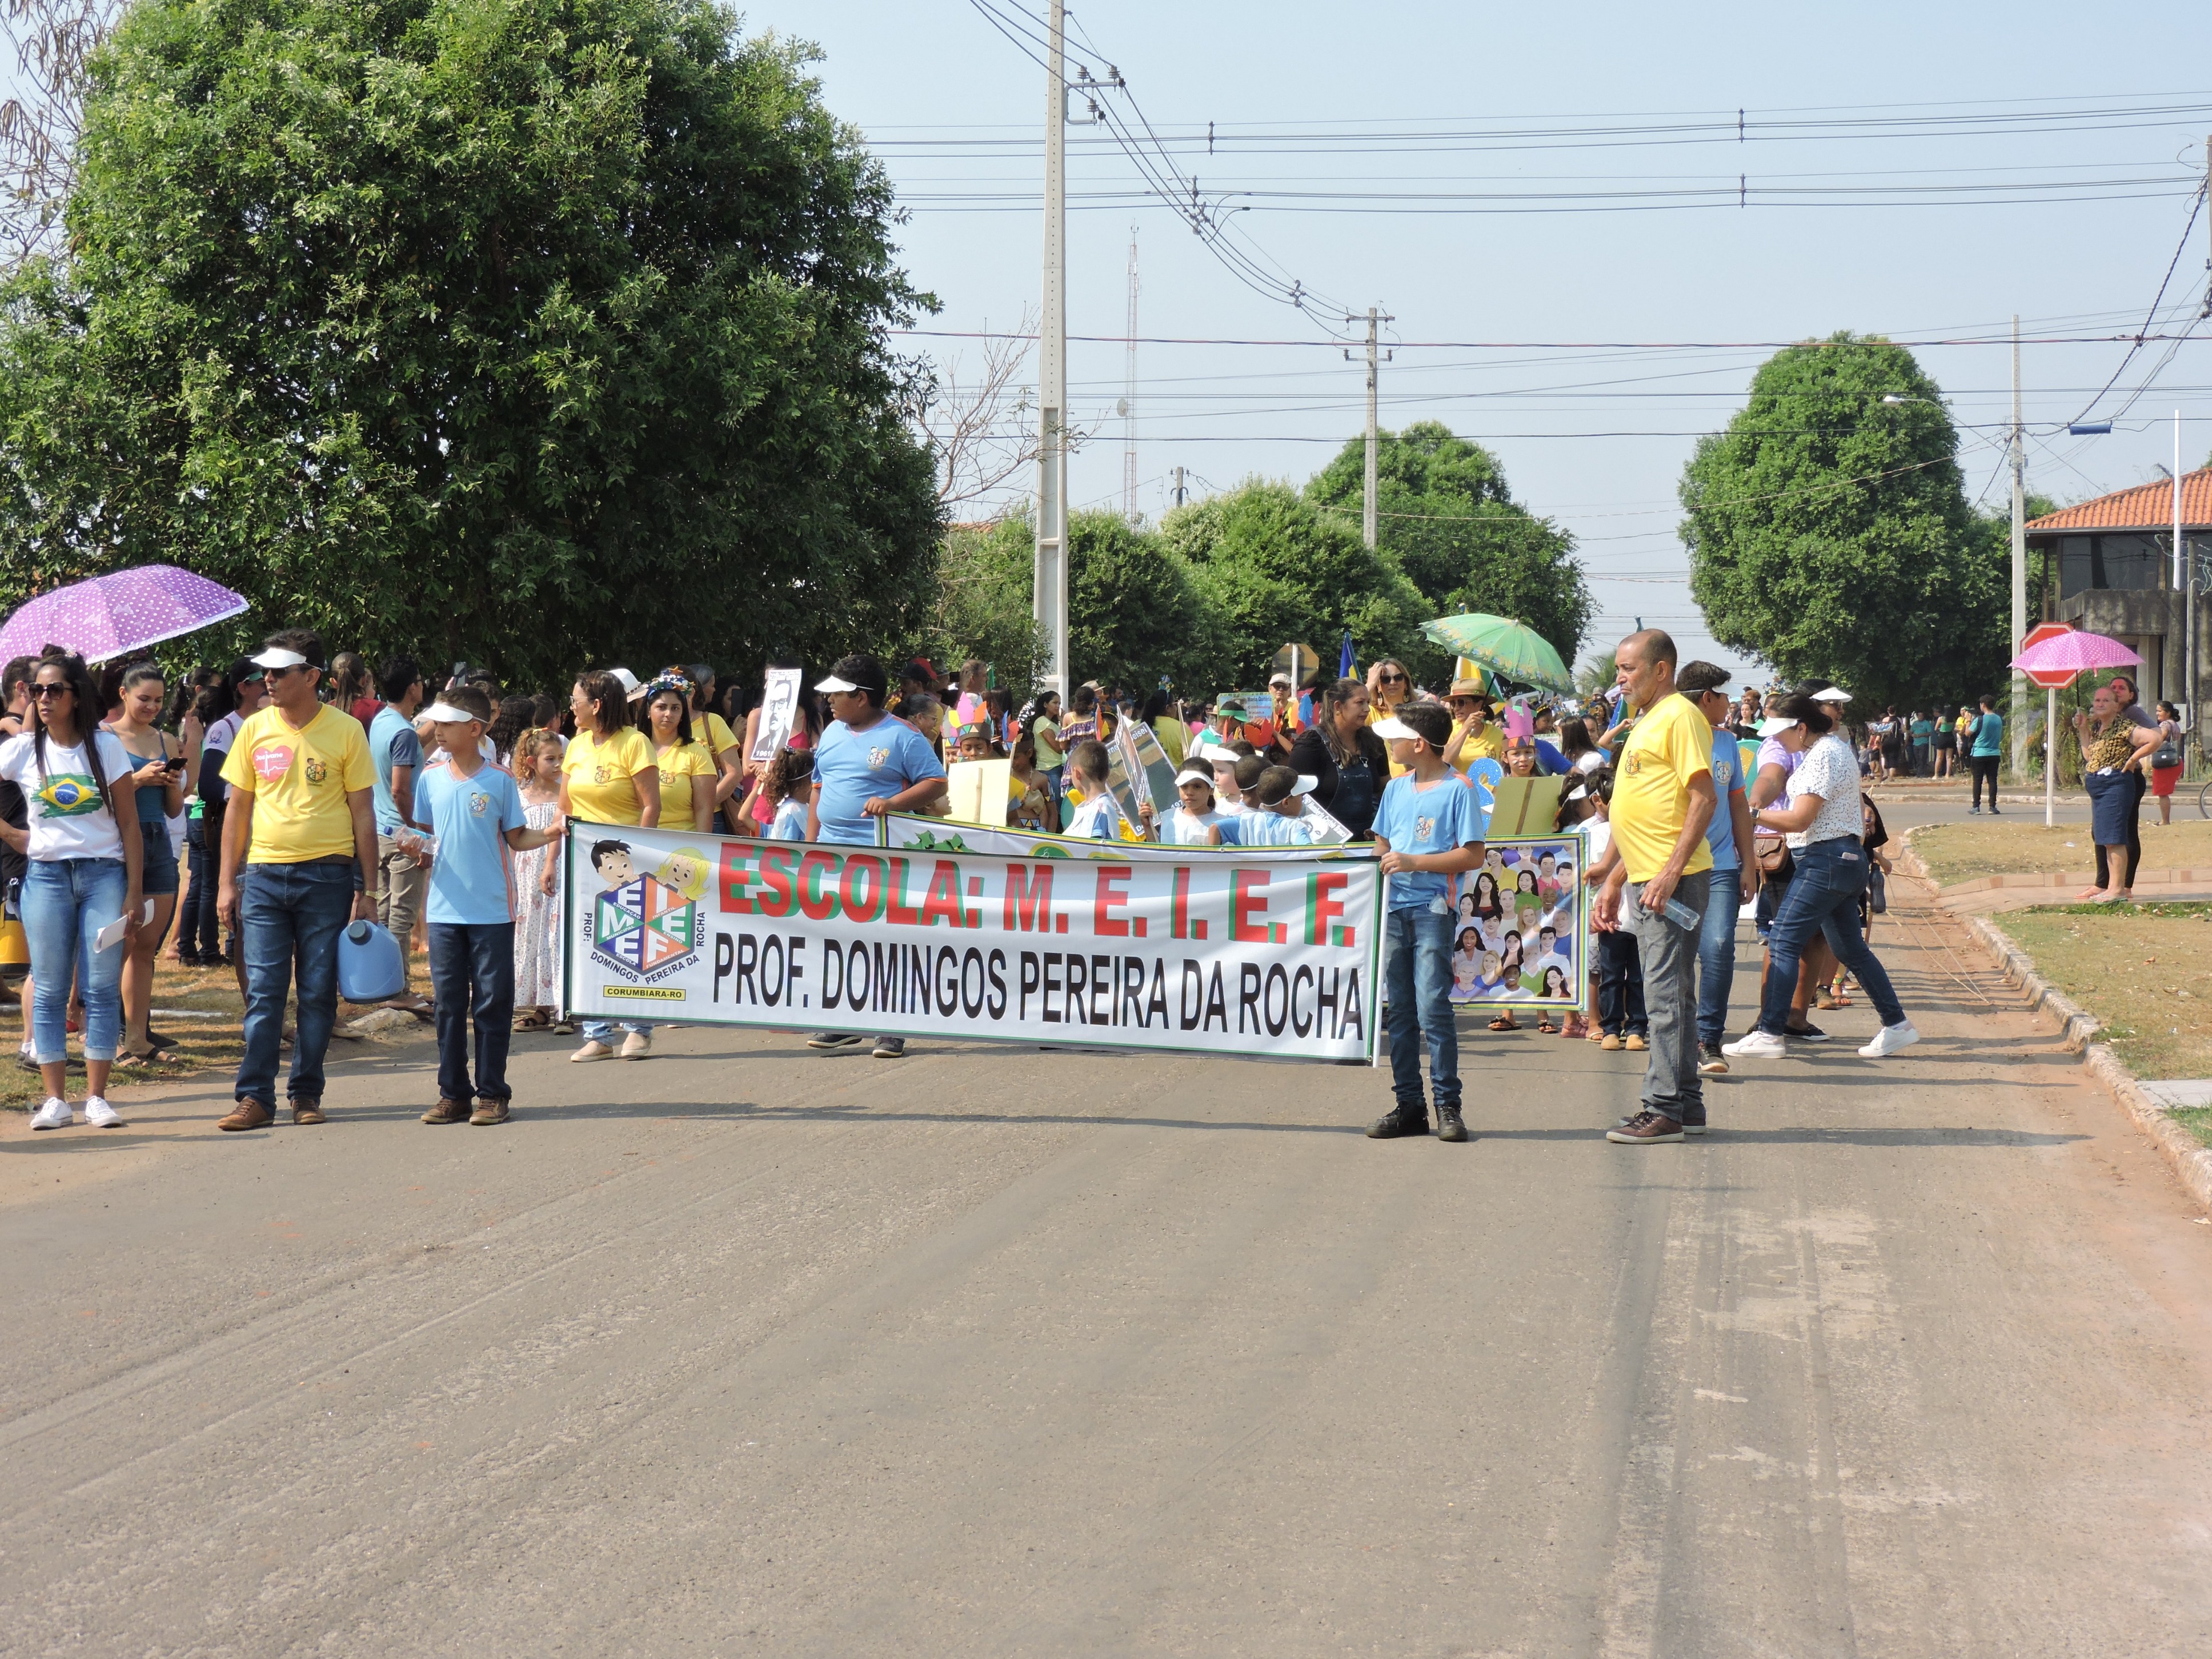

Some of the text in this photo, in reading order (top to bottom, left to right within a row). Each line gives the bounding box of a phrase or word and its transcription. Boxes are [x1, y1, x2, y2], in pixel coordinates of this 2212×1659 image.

[1131, 726, 1147, 742] eisel
[720, 843, 1356, 948] ESCOLA: M. E. I. E. F.
[613, 901, 641, 920] EDUCAÇÃO
[652, 906, 677, 920] INFANTIL
[583, 912, 593, 941] PROF:
[606, 925, 635, 940] MUNICIPAL
[696, 912, 706, 947] ROCHA
[663, 931, 683, 944] ENSINO
[590, 951, 700, 985] DOMINGOS PEREIRA DA
[616, 953, 637, 967] ESCOLA
[646, 949, 684, 969] FUNDAMENTAL
[607, 988, 682, 999] CORUMBIARA-RO
[714, 932, 1364, 1041] PROF. DOMINGOS PEREIRA DA ROCHA
